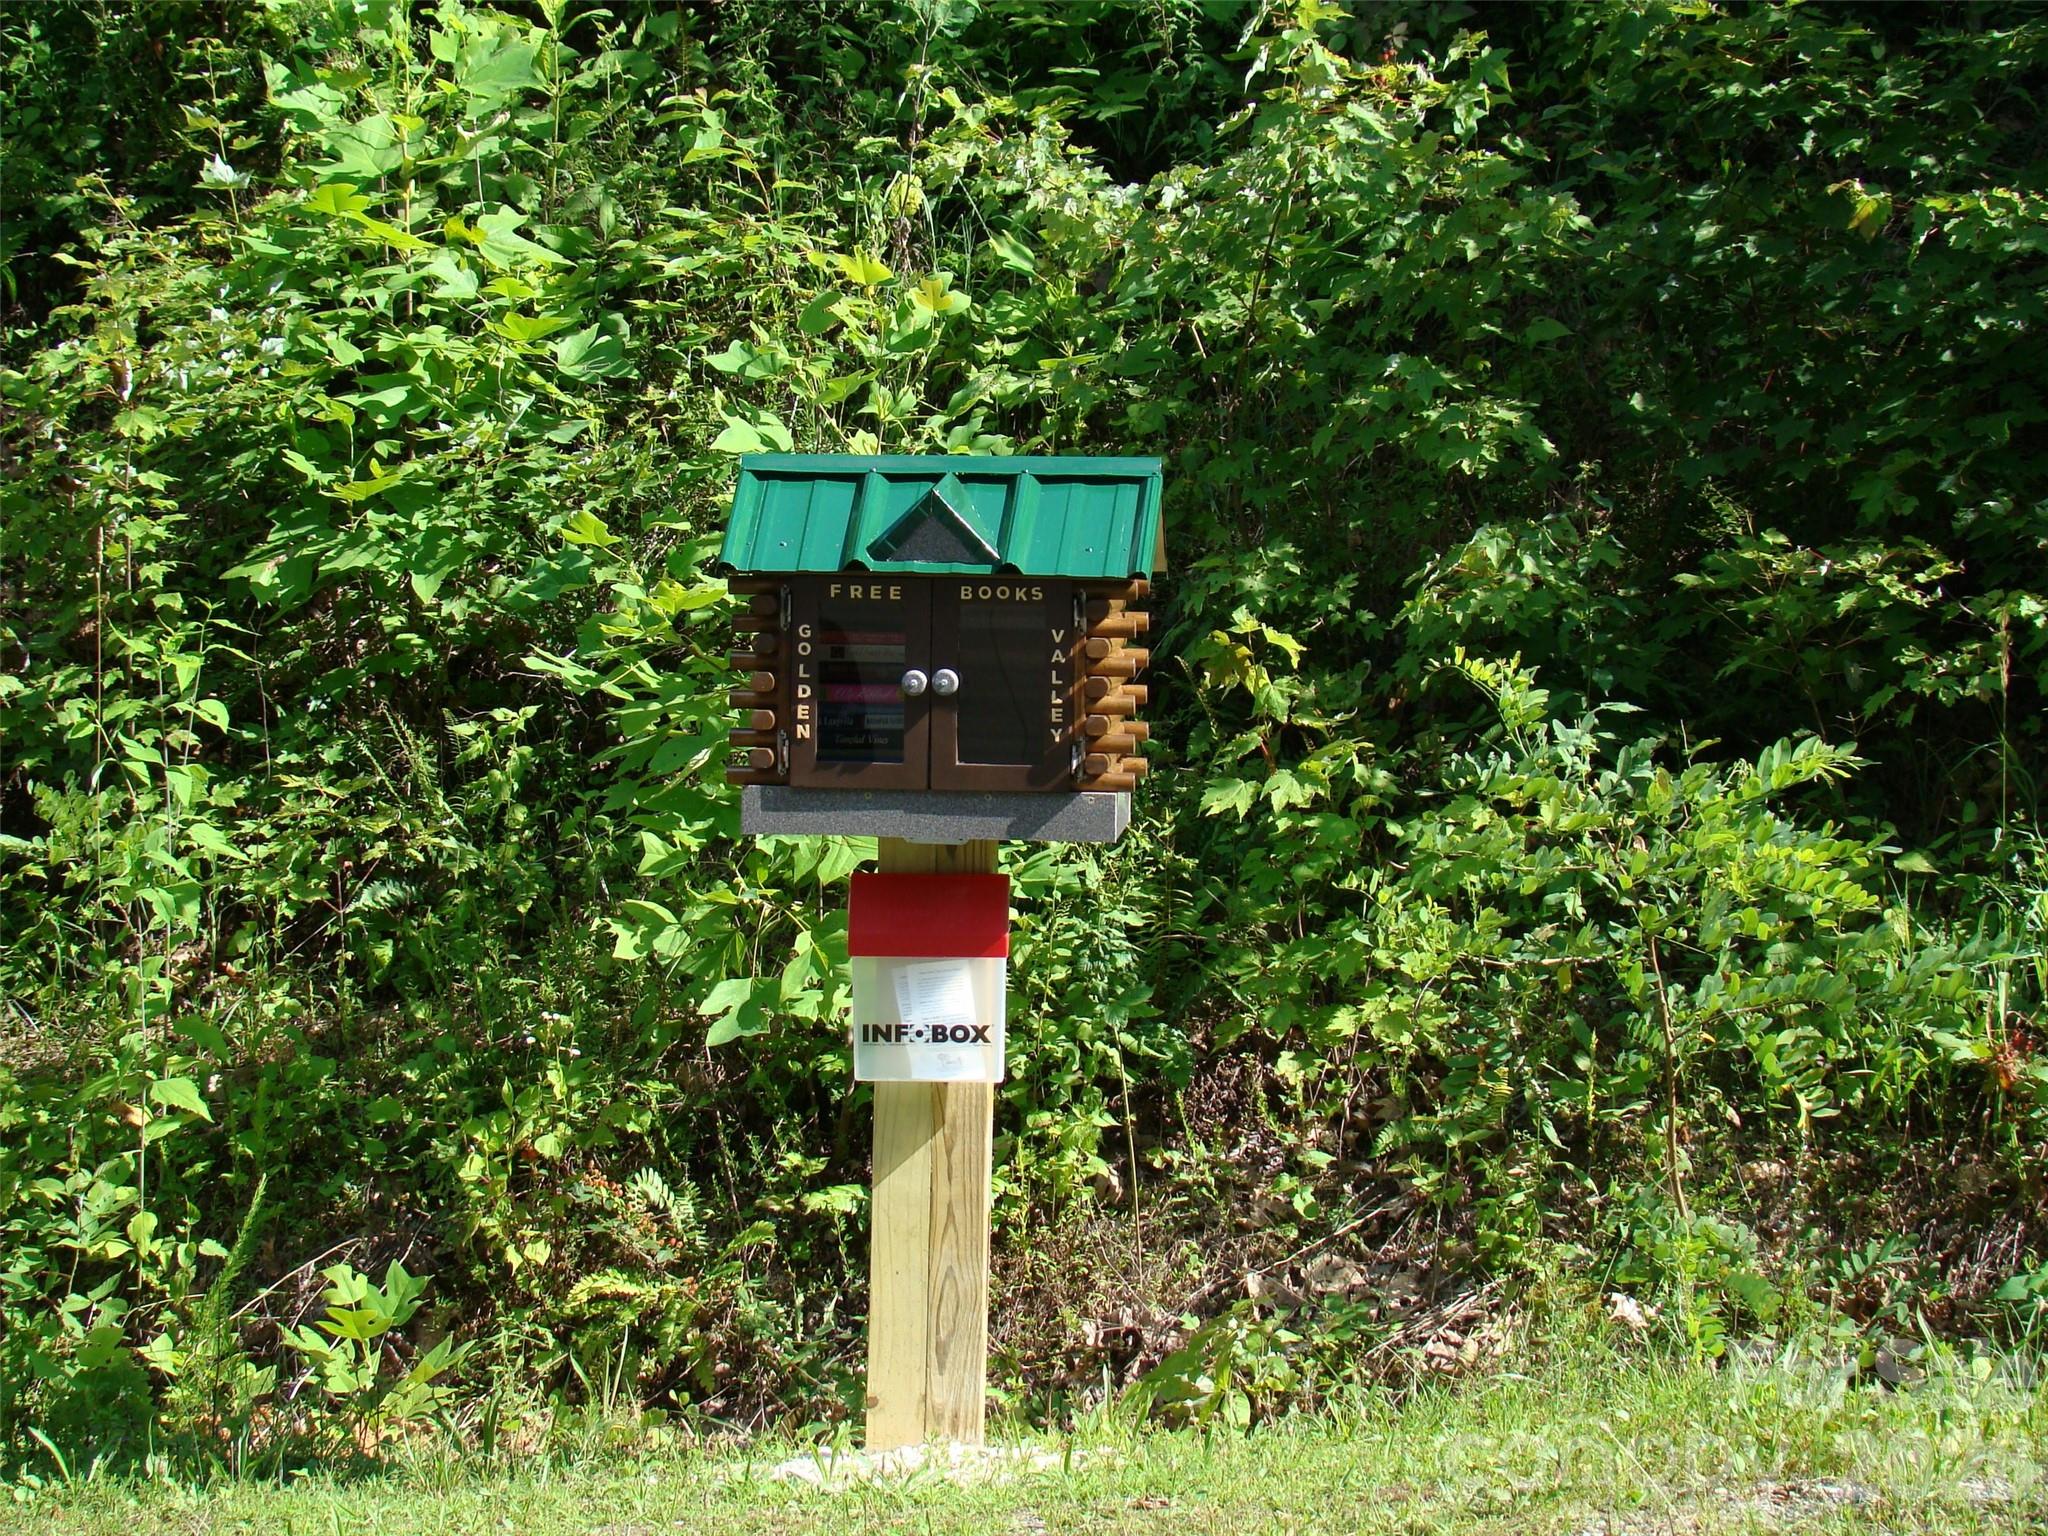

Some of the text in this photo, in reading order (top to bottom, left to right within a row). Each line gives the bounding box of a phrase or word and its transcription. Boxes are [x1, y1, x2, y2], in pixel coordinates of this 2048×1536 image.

[830, 583, 1044, 601] FREE BOOKS
[797, 624, 812, 740] GOLDEN
[1050, 629, 1066, 743] VALLEY
